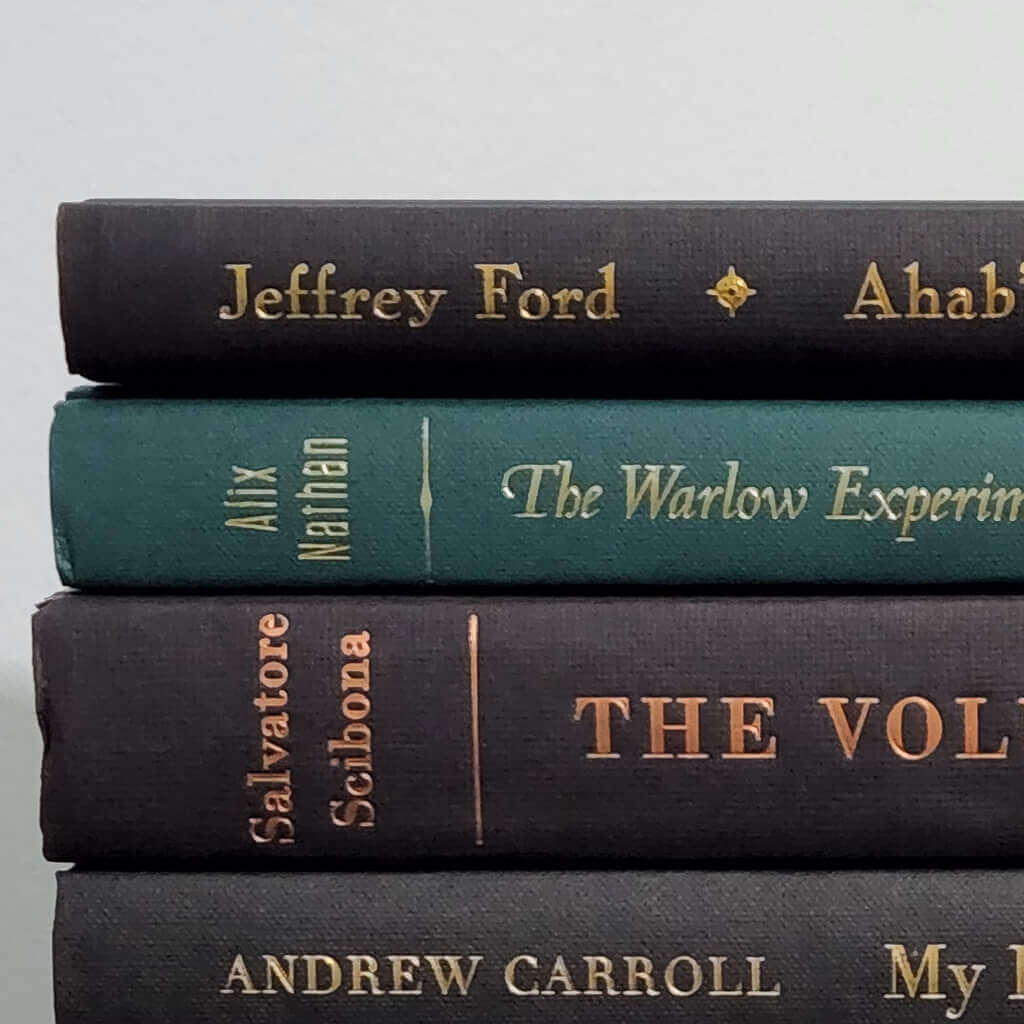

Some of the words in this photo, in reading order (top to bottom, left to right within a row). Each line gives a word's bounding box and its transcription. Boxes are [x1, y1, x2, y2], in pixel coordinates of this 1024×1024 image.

[218, 262, 448, 329] Jeffrey
[473, 261, 621, 320] Ford
[223, 465, 279, 532] Alix
[294, 437, 351, 561] Nathan
[502, 459, 603, 520] The
[619, 460, 810, 521] Warlow
[244, 612, 296, 846] Salvatore
[328, 630, 376, 828] Scibona
[574, 695, 778, 761] THE
[219, 954, 484, 997] ANDREW
[504, 954, 781, 997] CARROLL
[883, 942, 986, 1020] My
